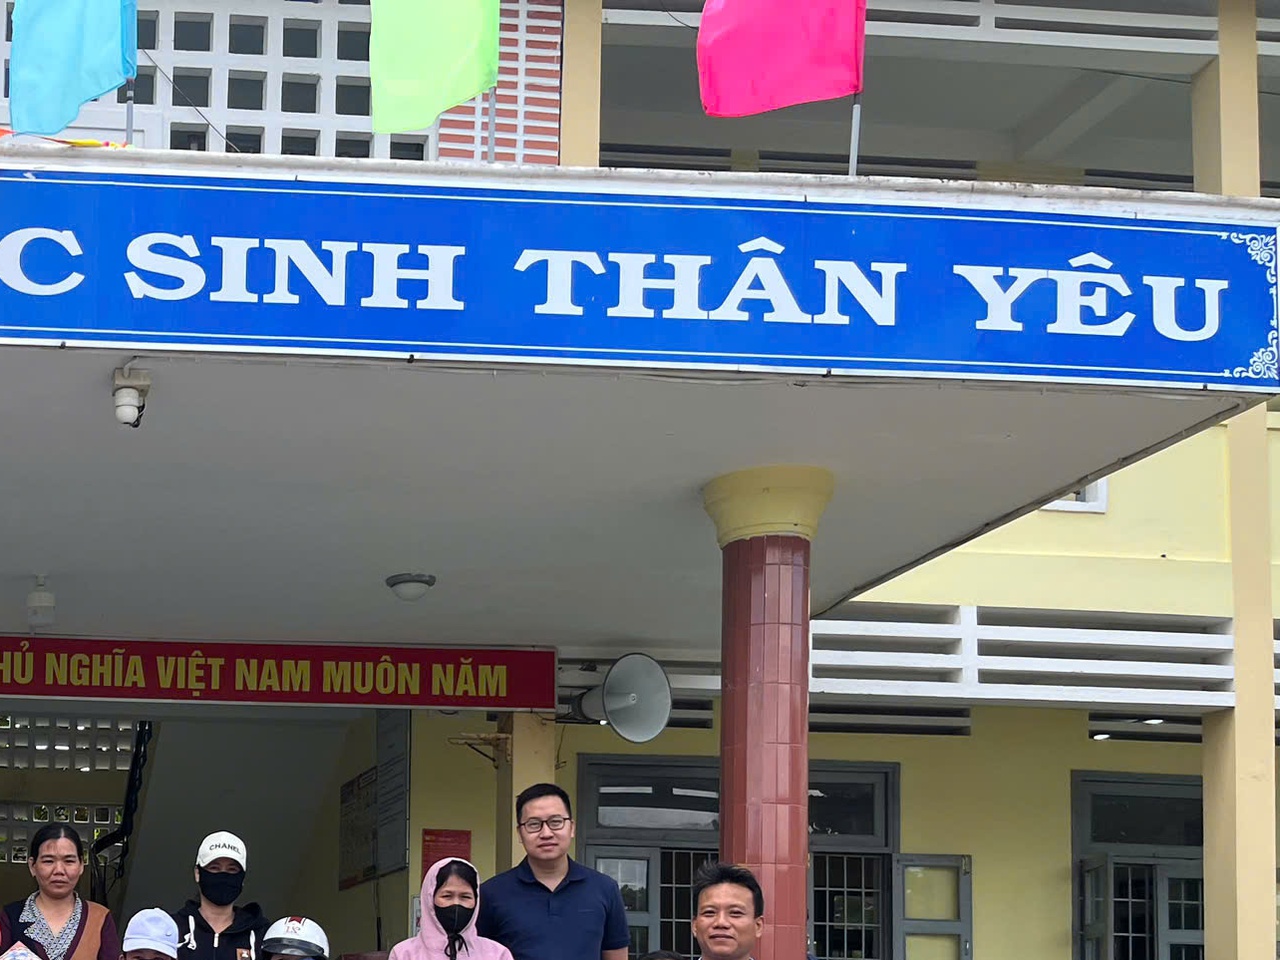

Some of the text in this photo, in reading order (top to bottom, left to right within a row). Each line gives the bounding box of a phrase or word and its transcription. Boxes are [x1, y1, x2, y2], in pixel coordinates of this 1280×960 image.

[124, 233, 465, 310] SINH
[514, 237, 906, 325] THÂN
[953, 252, 1228, 341] YÊU
[47, 649, 145, 688] NGHĨA
[157, 651, 224, 697] VIỆT
[237, 659, 310, 692] NAM
[323, 655, 420, 695] MUÔN
[433, 658, 507, 697] NĂM
[209, 843, 241, 854] CHANEL
